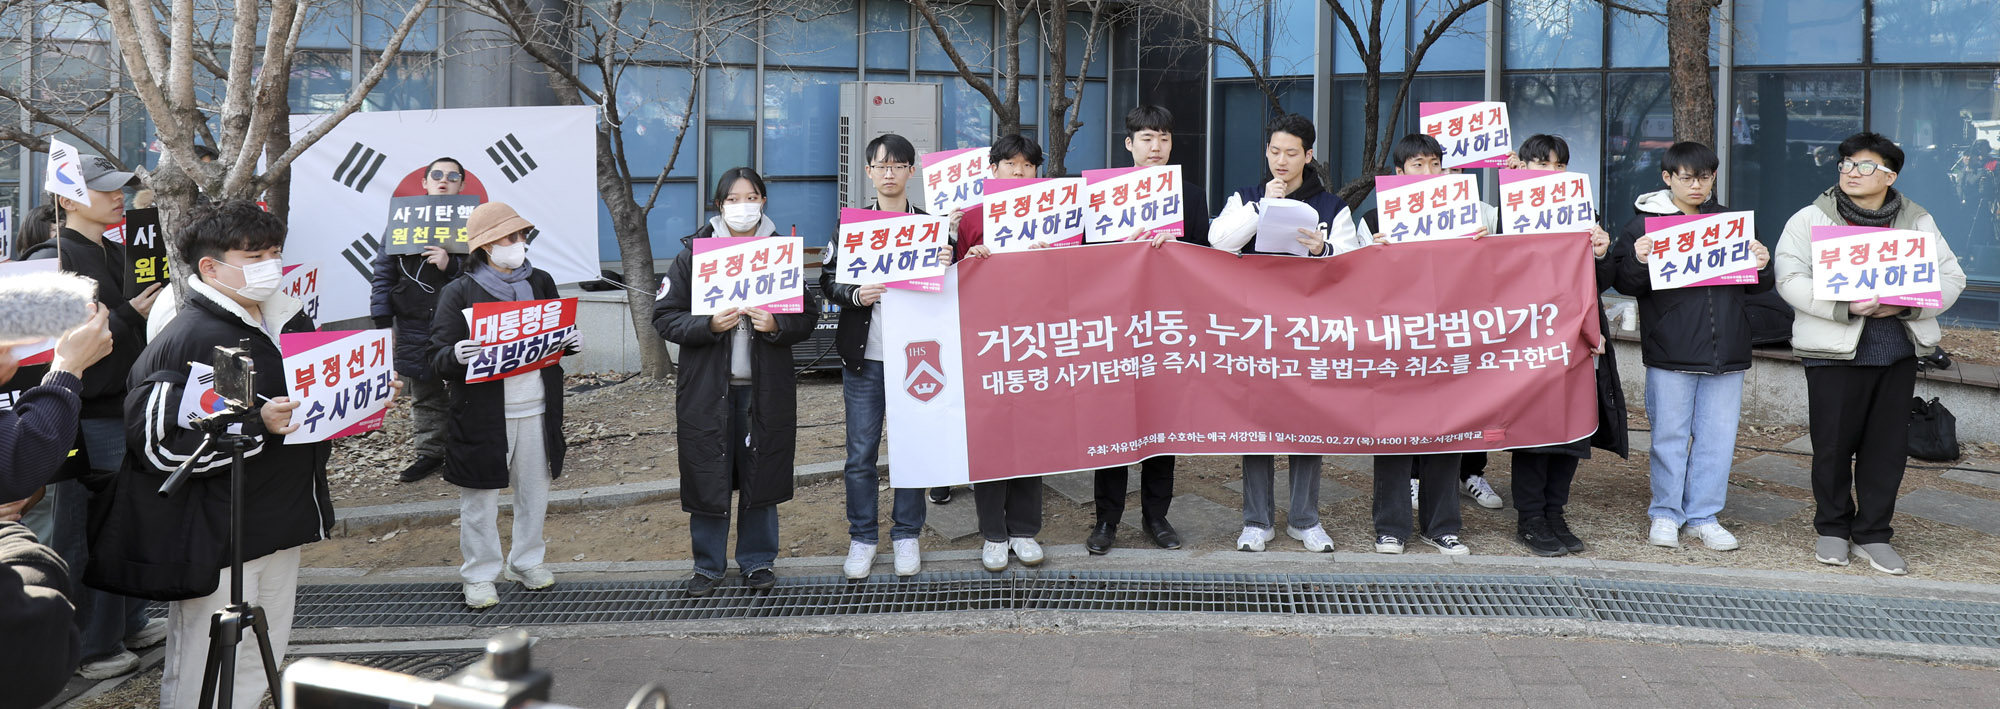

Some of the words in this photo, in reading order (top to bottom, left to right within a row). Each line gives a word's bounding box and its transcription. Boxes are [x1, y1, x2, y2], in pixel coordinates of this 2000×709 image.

[1427, 107, 1502, 138] 부정선거
[928, 154, 991, 190] 부정선
[1089, 171, 1173, 212] 부정선거
[393, 205, 475, 223] 사기탄핵
[988, 183, 1078, 223] 부정선거
[1095, 193, 1180, 236] 수사하라
[1384, 180, 1469, 220] 부정선거
[1506, 179, 1585, 212] 부정선거
[994, 207, 1083, 247] 수사하라
[1390, 203, 1478, 242] 수사하라
[1513, 201, 1593, 233] 수사하라
[844, 222, 940, 253] 부정선거
[1652, 217, 1744, 259] 부정선거
[1819, 237, 1926, 270] 부정선거
[698, 243, 794, 283] 부정선거
[847, 247, 943, 278] 수사하라
[1660, 240, 1750, 282] 수사하라
[1826, 262, 1935, 294] 수사하라
[704, 267, 800, 308] 수사하라
[475, 301, 562, 344] 대통령을
[977, 316, 1118, 362] 거짓말과
[1124, 310, 1197, 347] 선동,
[1205, 313, 1277, 350] 누가
[1285, 315, 1358, 351] 진짜
[1365, 304, 1559, 351] 내란범인가?
[295, 337, 385, 398] 부정선거
[909, 347, 927, 357] IHS
[982, 368, 1049, 395] 대통령
[1055, 353, 1158, 388] 사기탄핵을
[1162, 351, 1206, 374] 즉시
[1212, 353, 1301, 379] 각하하고
[1307, 356, 1400, 379] 불법구속
[1404, 353, 1472, 377] 취소를
[1476, 342, 1571, 371] 요구한다
[303, 370, 391, 433] 수사하라
[1087, 444, 1109, 456] 주최:
[1110, 432, 1166, 452] 자유민주주의를
[1167, 432, 1206, 442] 수호하는
[1207, 432, 1226, 442] 애국
[1229, 431, 1267, 442] 서강인들
[1274, 432, 1297, 443] 일시:
[1298, 435, 1325, 444] 2025.
[1326, 436, 1341, 445] 02.
[1343, 437, 1355, 445] 27
[1357, 437, 1374, 446] (목)
[1376, 437, 1402, 445] 14:00
[1409, 437, 1432, 445] 장소:
[1434, 431, 1483, 444] 서강대학교
